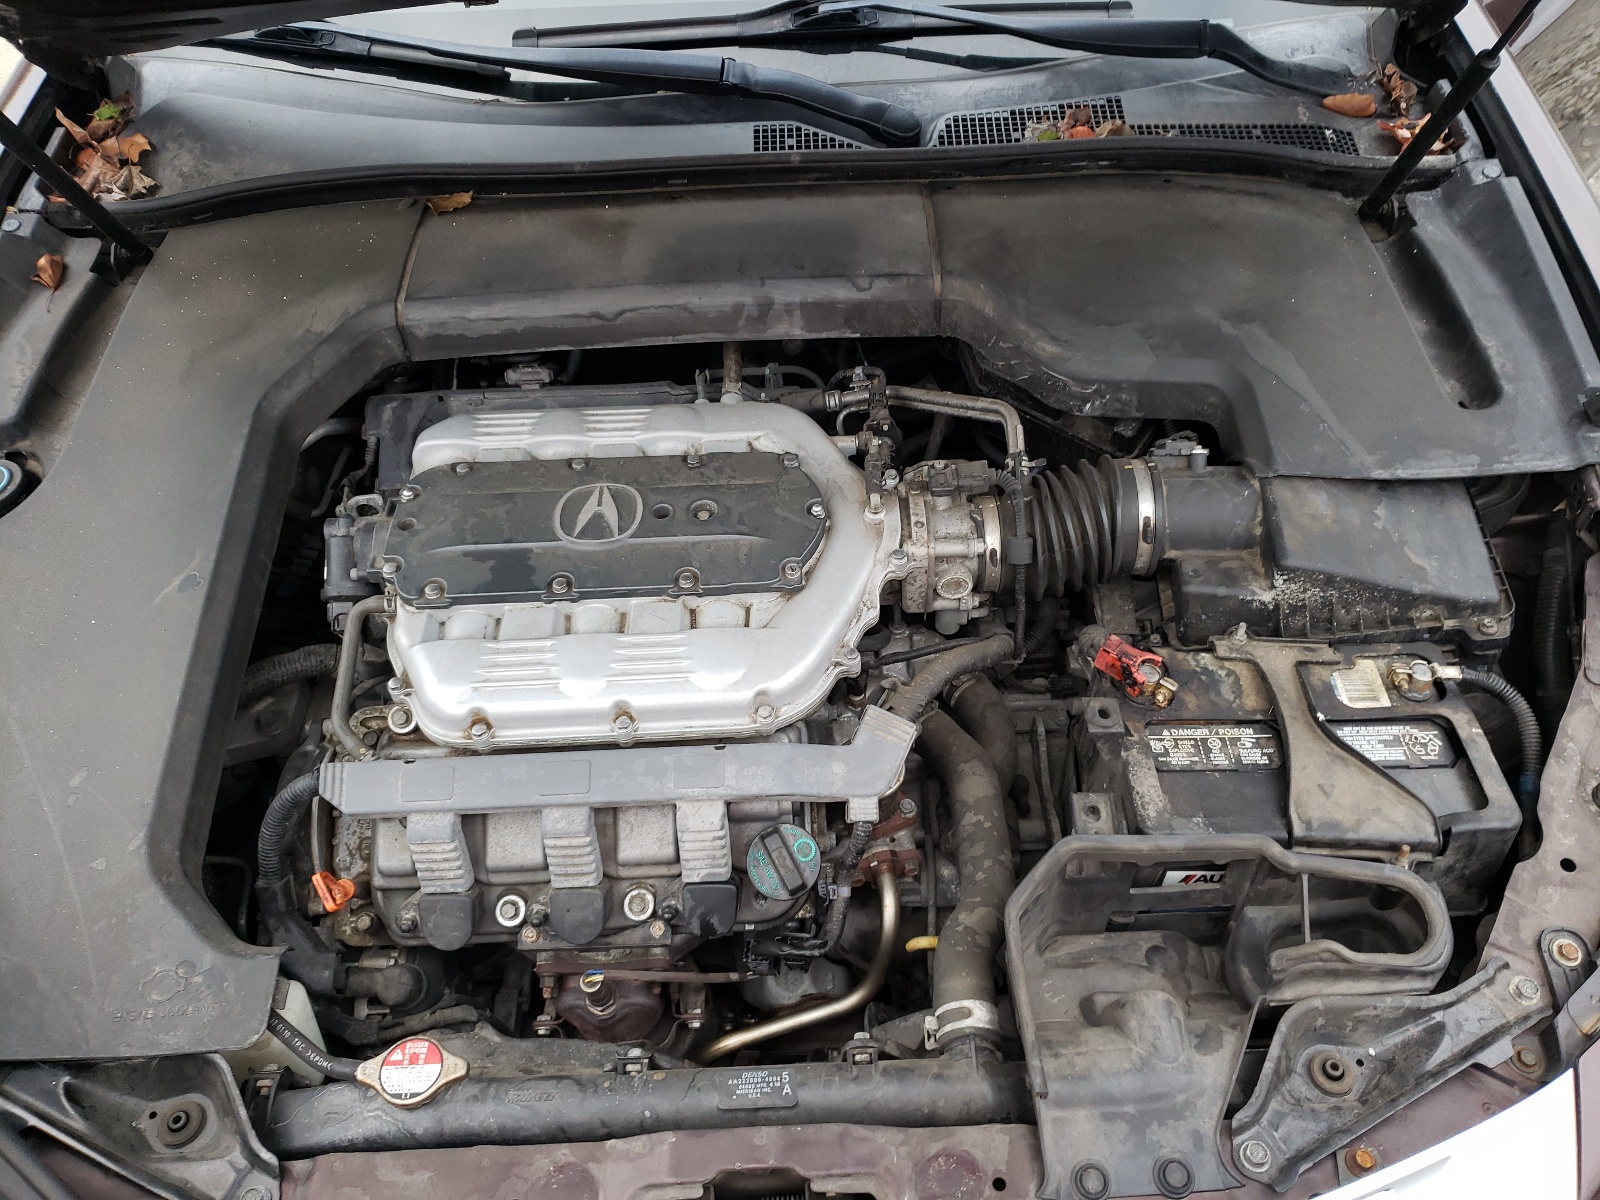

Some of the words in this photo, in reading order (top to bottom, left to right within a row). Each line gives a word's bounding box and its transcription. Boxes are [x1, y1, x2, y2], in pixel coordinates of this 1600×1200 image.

[1171, 728, 1209, 736] DANGER
[1219, 727, 1254, 736] POISON
[756, 850, 768, 867] SAE
[291, 1037, 306, 1051] TPC
[741, 1070, 768, 1079] DENSO
[781, 1071, 790, 1083] 5
[782, 1083, 793, 1096] A
